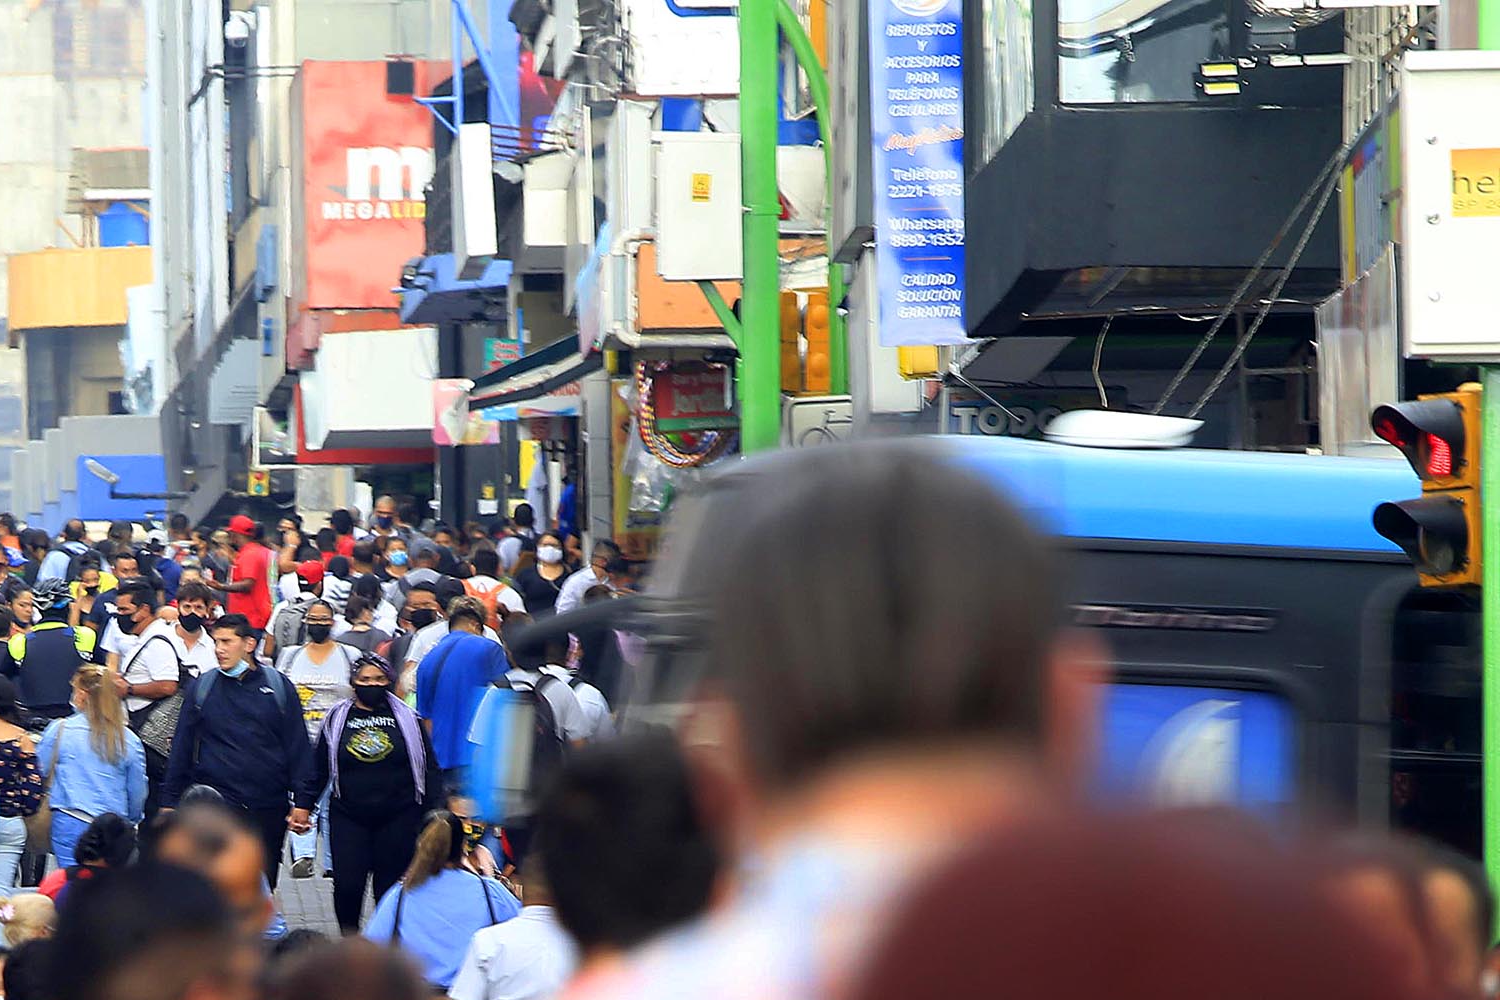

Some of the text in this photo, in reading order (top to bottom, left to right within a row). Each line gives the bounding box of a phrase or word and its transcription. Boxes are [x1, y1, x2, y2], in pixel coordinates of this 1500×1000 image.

[886, 23, 957, 37] REPUESTOS
[916, 40, 928, 52] Y
[884, 55, 961, 68] ACCESORIOS
[905, 71, 940, 84] PARA
[889, 103, 958, 116] CELULARES
[901, 273, 956, 286] CALIDAD
